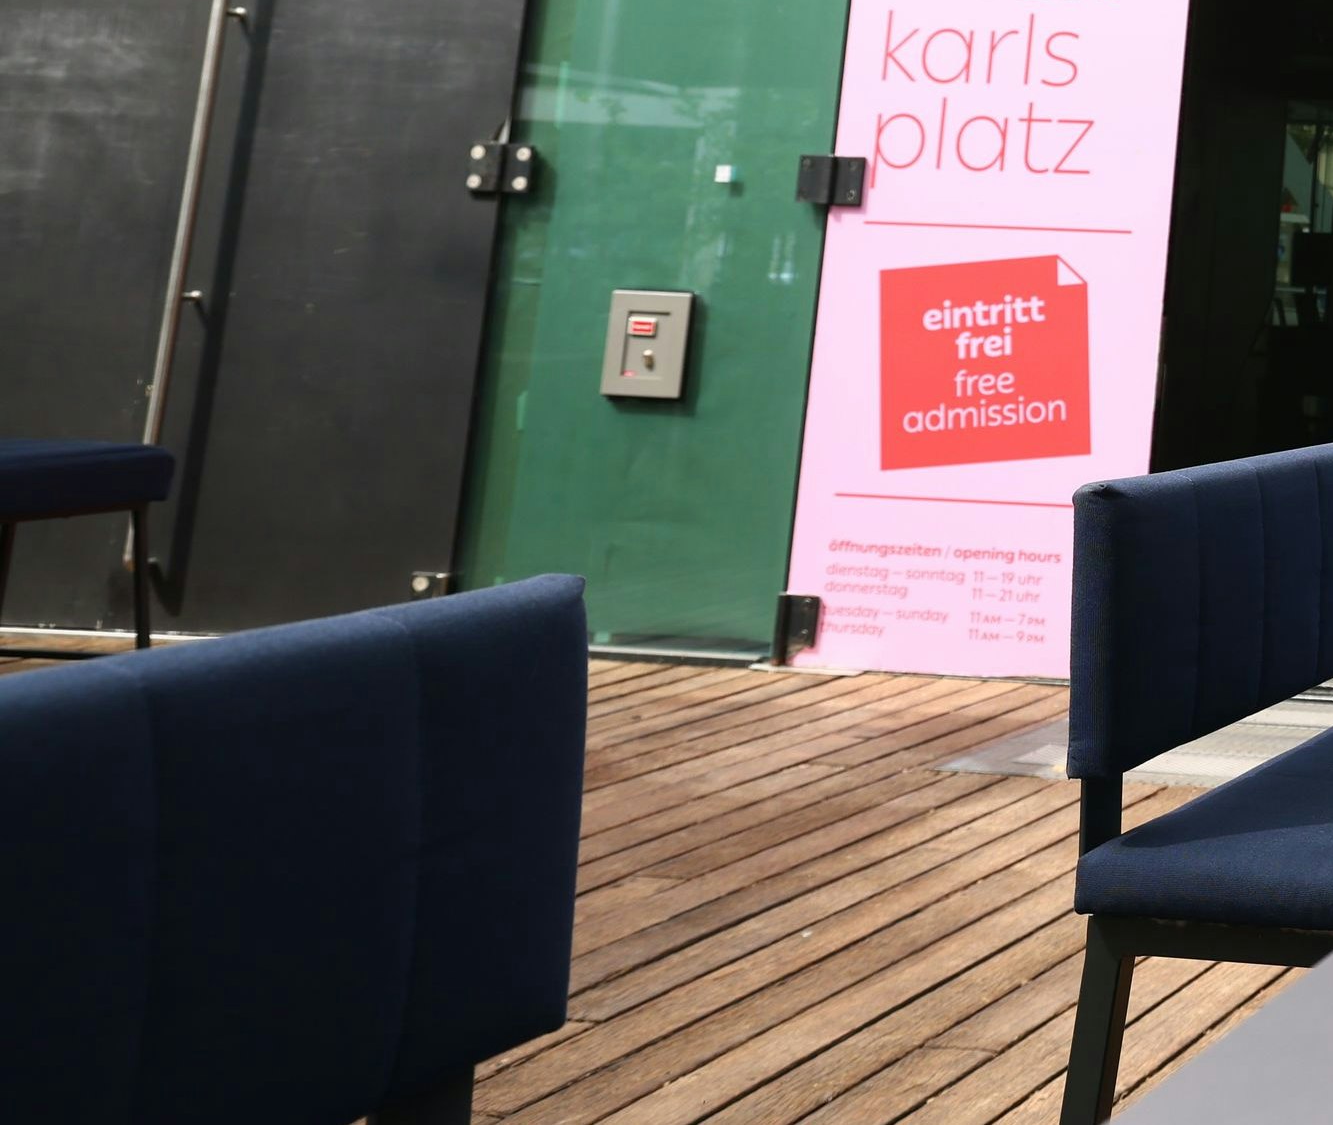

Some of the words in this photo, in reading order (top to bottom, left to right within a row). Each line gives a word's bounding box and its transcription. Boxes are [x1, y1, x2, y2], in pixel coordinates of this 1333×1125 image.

[881, 9, 1080, 87] karls
[869, 97, 1095, 189] platz
[922, 294, 1046, 331] eintritt
[955, 325, 1013, 360] frei
[954, 369, 1016, 398] free
[902, 395, 1067, 434] admission
[828, 539, 942, 558] öffnungszeiten
[953, 546, 1015, 564] opening
[1018, 549, 1062, 564] hours
[826, 562, 889, 581] dienstag
[905, 567, 966, 585] sonntag
[973, 570, 984, 583] 11
[1002, 571, 1015, 584] 19
[1018, 572, 1043, 586] uhr
[824, 581, 909, 599] donnerstag
[972, 587, 983, 600] 11
[999, 588, 1013, 602] 21
[1016, 589, 1041, 603] uhr
[826, 605, 880, 621] uesday
[896, 608, 949, 625] sunday
[825, 622, 886, 638] hursday
